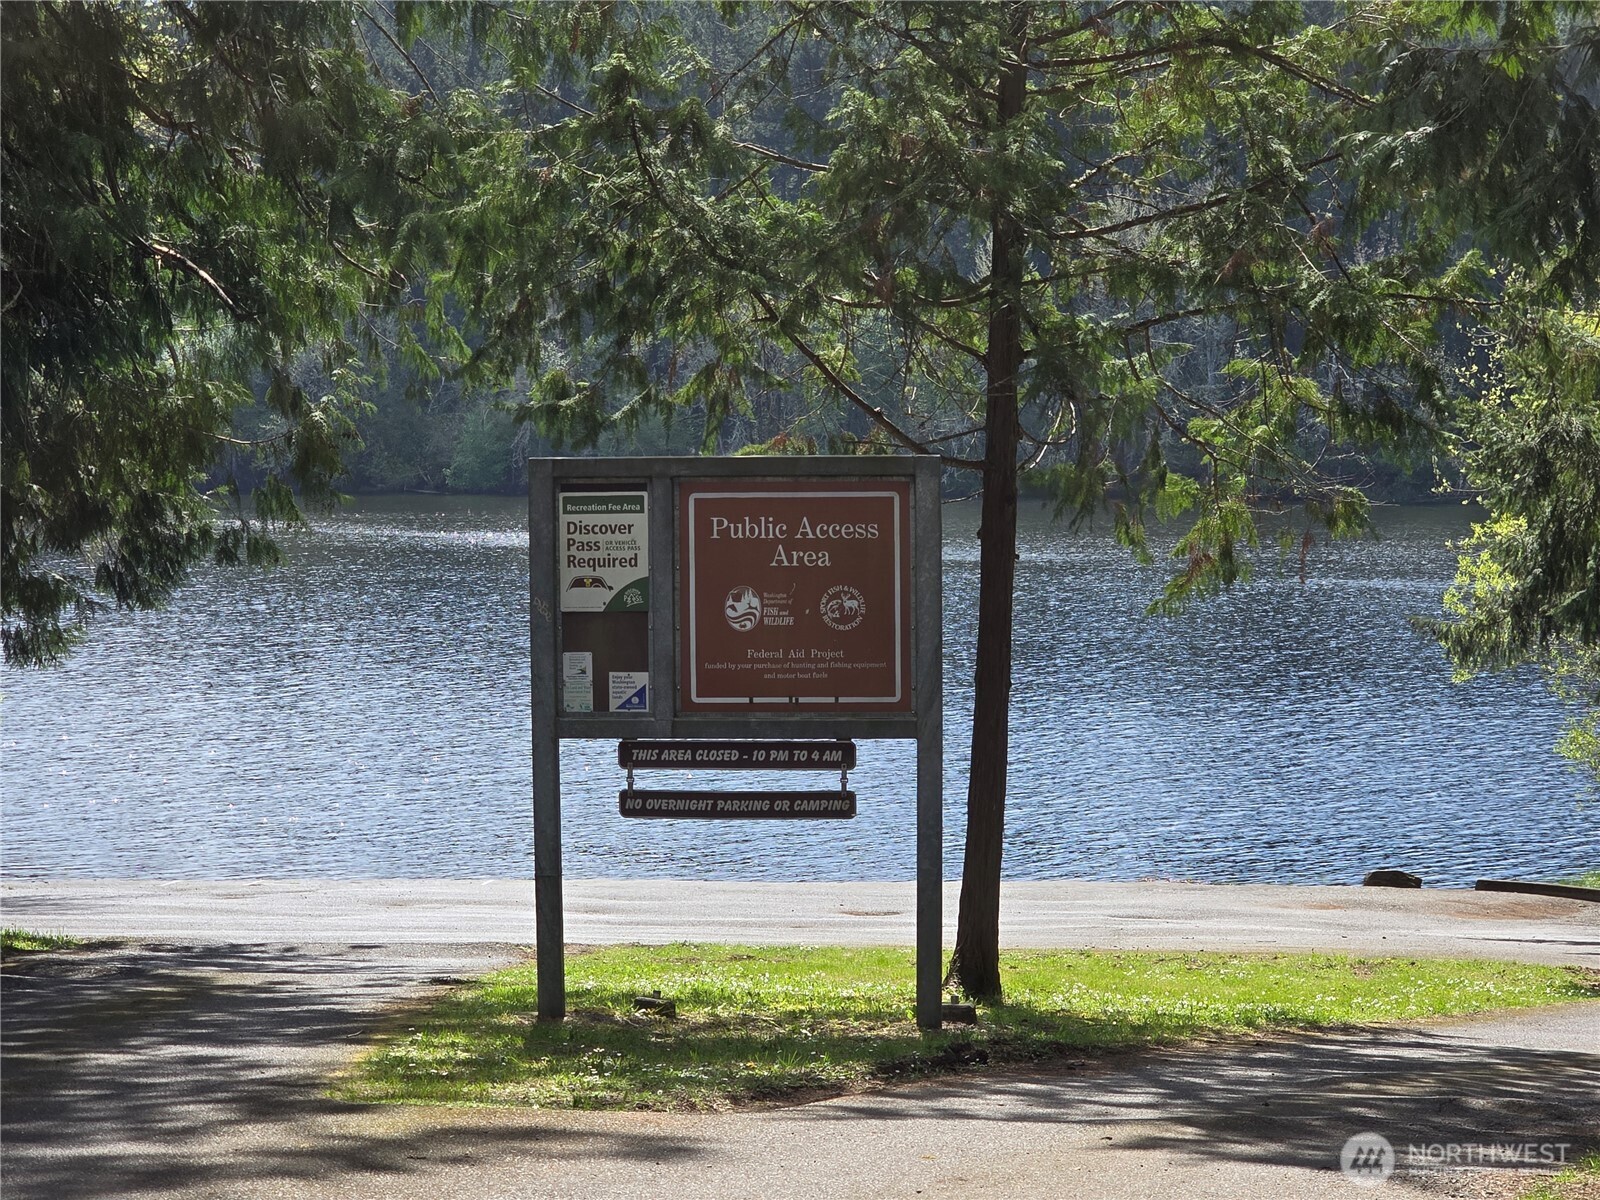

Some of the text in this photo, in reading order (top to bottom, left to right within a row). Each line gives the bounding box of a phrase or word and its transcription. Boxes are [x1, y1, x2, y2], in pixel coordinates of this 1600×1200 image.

[566, 504, 607, 512] Recreation
[566, 520, 634, 535] Discover
[710, 516, 879, 539] Public Access
[566, 538, 600, 552] Pass
[770, 544, 832, 566] Area
[567, 553, 638, 572] Required
[763, 606, 779, 616] FISH
[763, 616, 794, 626] WILDLIFE
[747, 648, 844, 660] Federal Aid Project
[728, 662, 736, 670] by
[754, 662, 782, 670] purchase
[830, 661, 852, 669] fishing
[632, 749, 659, 760] THIS
[661, 749, 692, 761] AREA
[696, 750, 740, 760] CLOSED
[752, 750, 766, 761] 10
[770, 750, 789, 761] PM
[793, 750, 808, 761] TO
[811, 750, 820, 761] 4
[822, 750, 842, 761] AM
[625, 798, 850, 811] NO OVERNIGHT PARKING OR CAMPING
